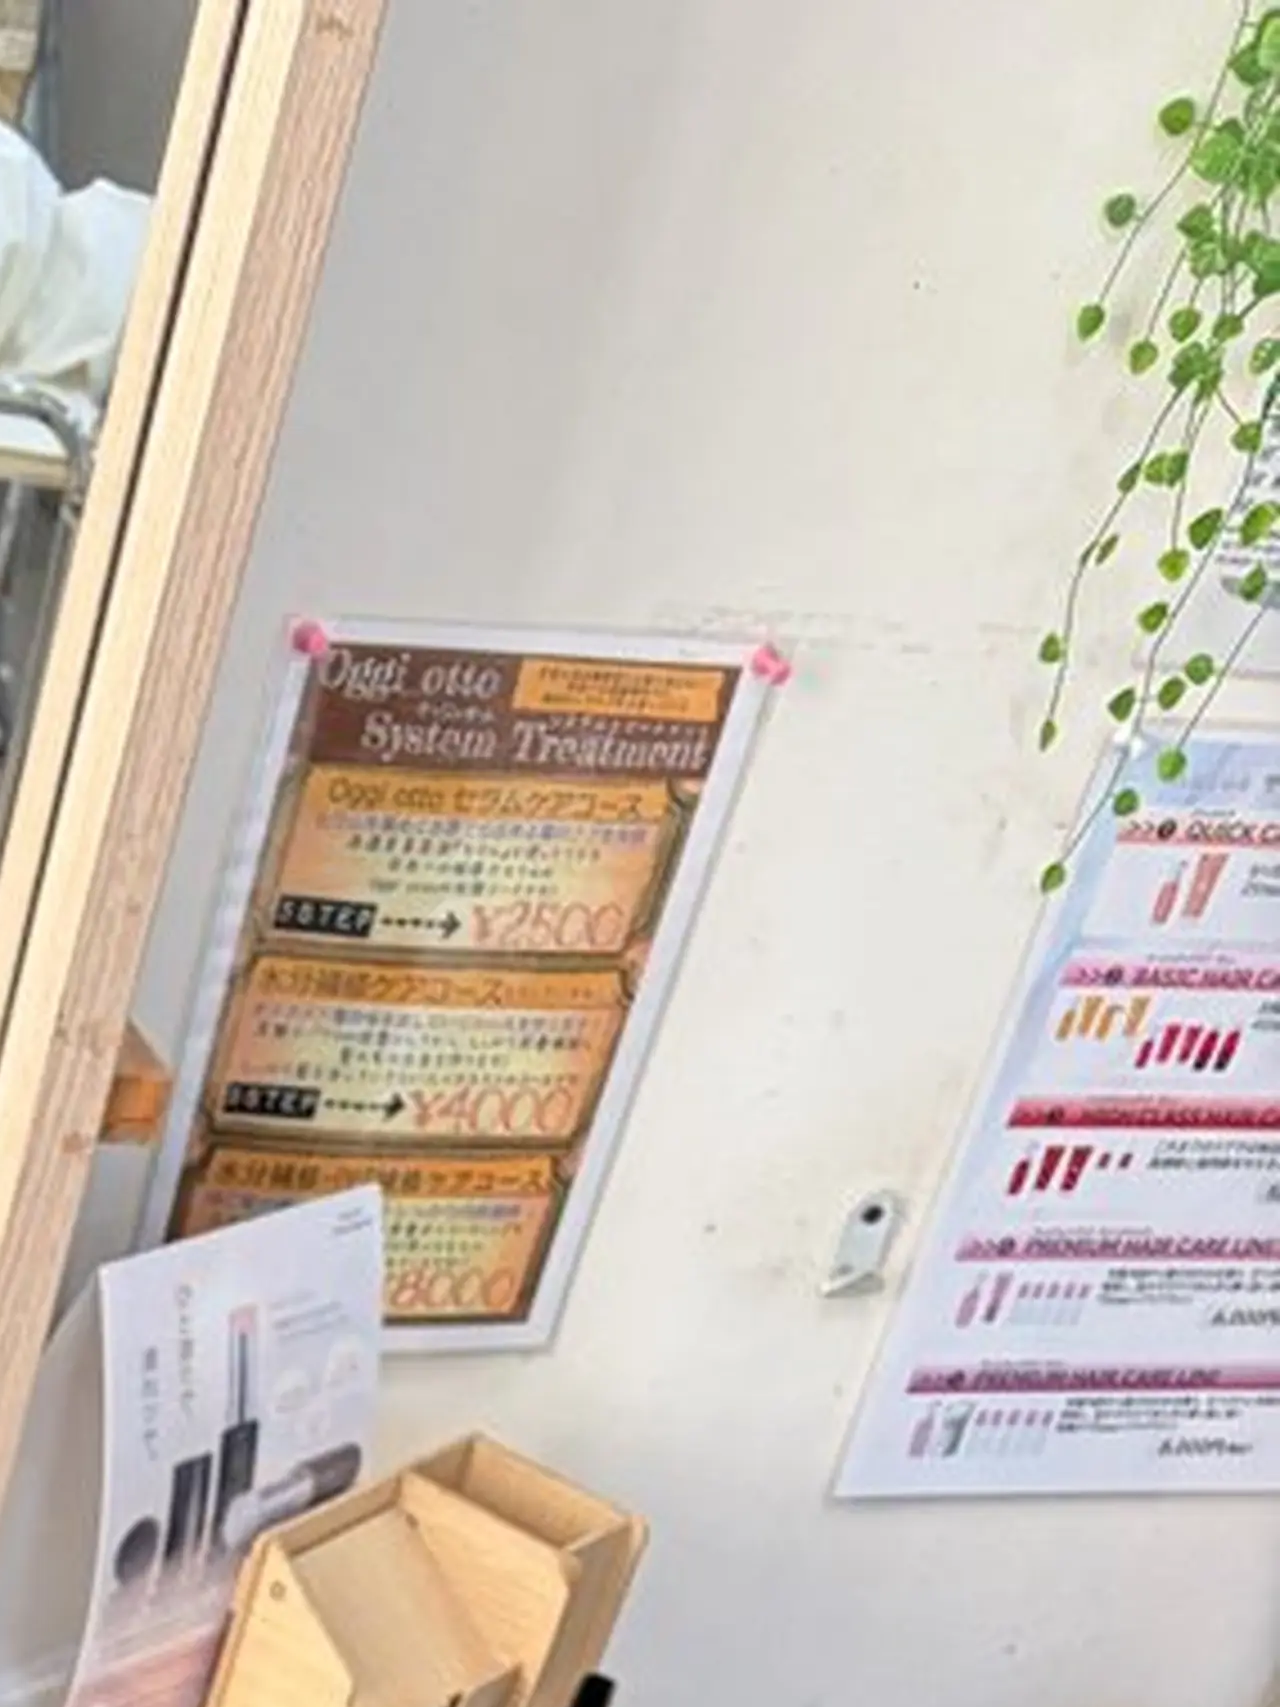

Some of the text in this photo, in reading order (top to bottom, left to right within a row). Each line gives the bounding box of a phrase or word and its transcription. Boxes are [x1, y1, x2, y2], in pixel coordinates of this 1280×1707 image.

[320, 648, 412, 701] Oggi
[420, 660, 501, 697] otto
[361, 711, 497, 762] System
[512, 720, 708, 771] Treatment
